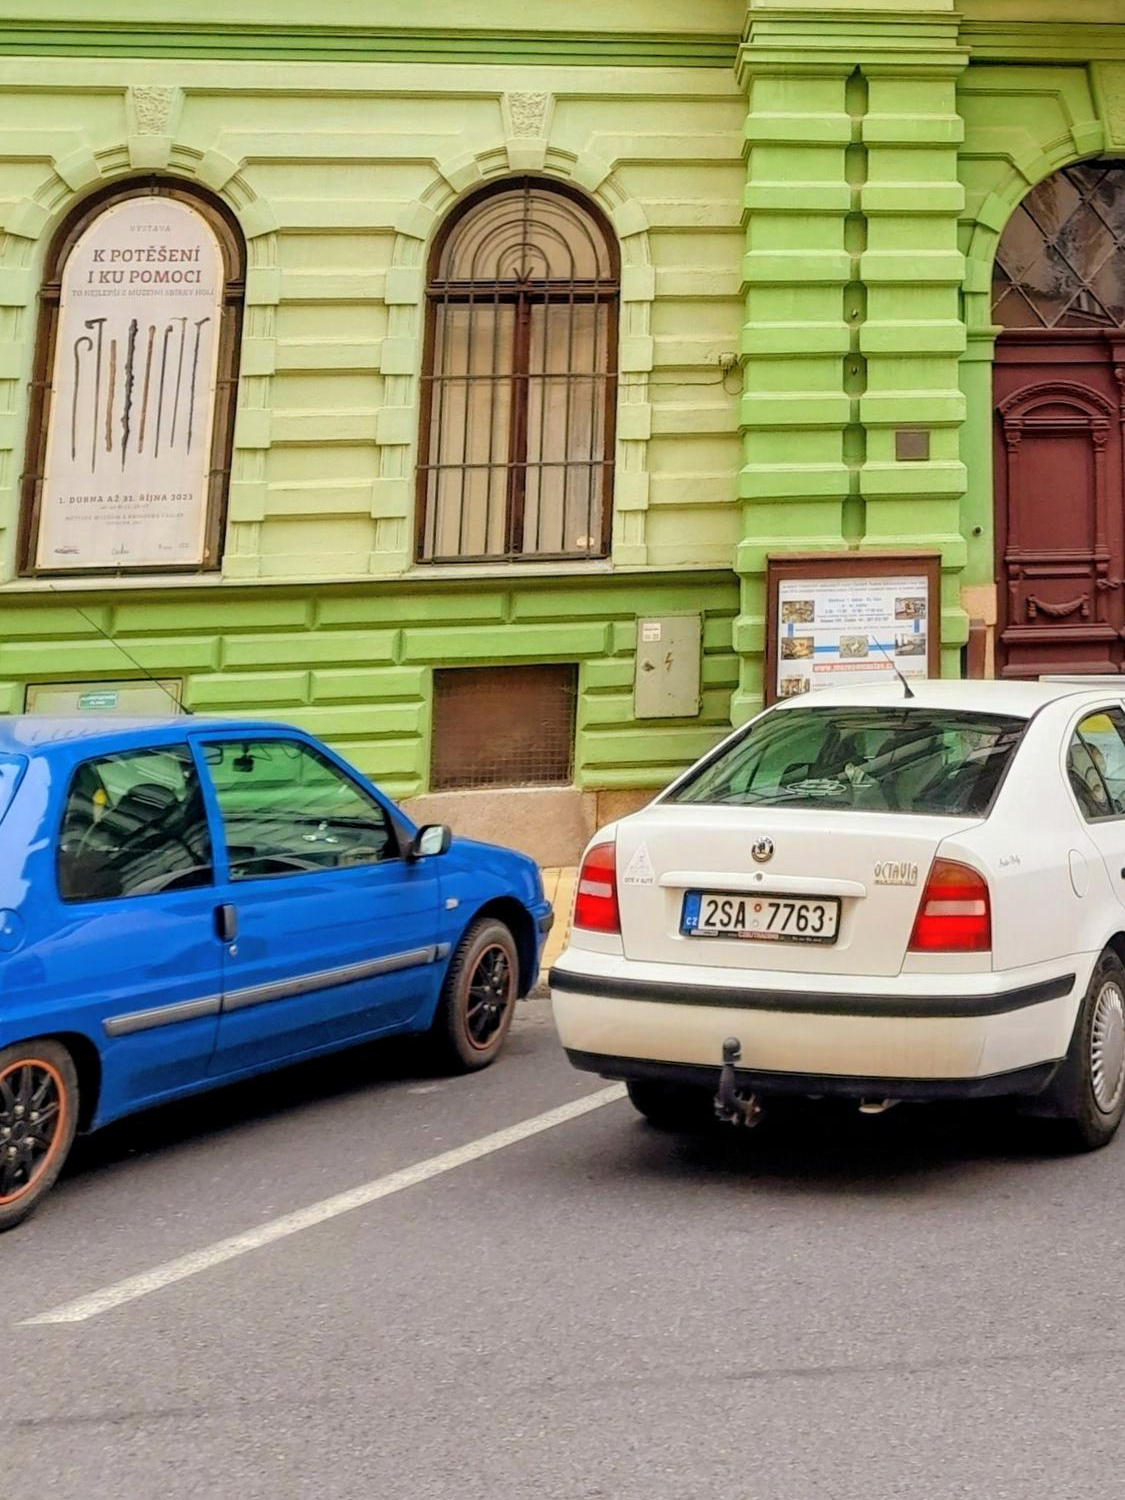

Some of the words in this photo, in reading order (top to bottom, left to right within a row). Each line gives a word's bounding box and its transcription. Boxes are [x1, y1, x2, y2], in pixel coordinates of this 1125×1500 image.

[93, 249, 105, 262] K
[110, 245, 201, 262] POTĚŠENÍ
[87, 270, 94, 283] I
[98, 270, 124, 283] KU
[129, 270, 203, 283] POMOCI
[69, 495, 103, 504] DUBNA
[107, 493, 120, 503] AŽ
[170, 493, 193, 501] 2023
[874, 861, 918, 882] OCTAVIA
[686, 917, 697, 926] CZ
[703, 899, 746, 929] 2SA
[766, 902, 825, 932] 7763
